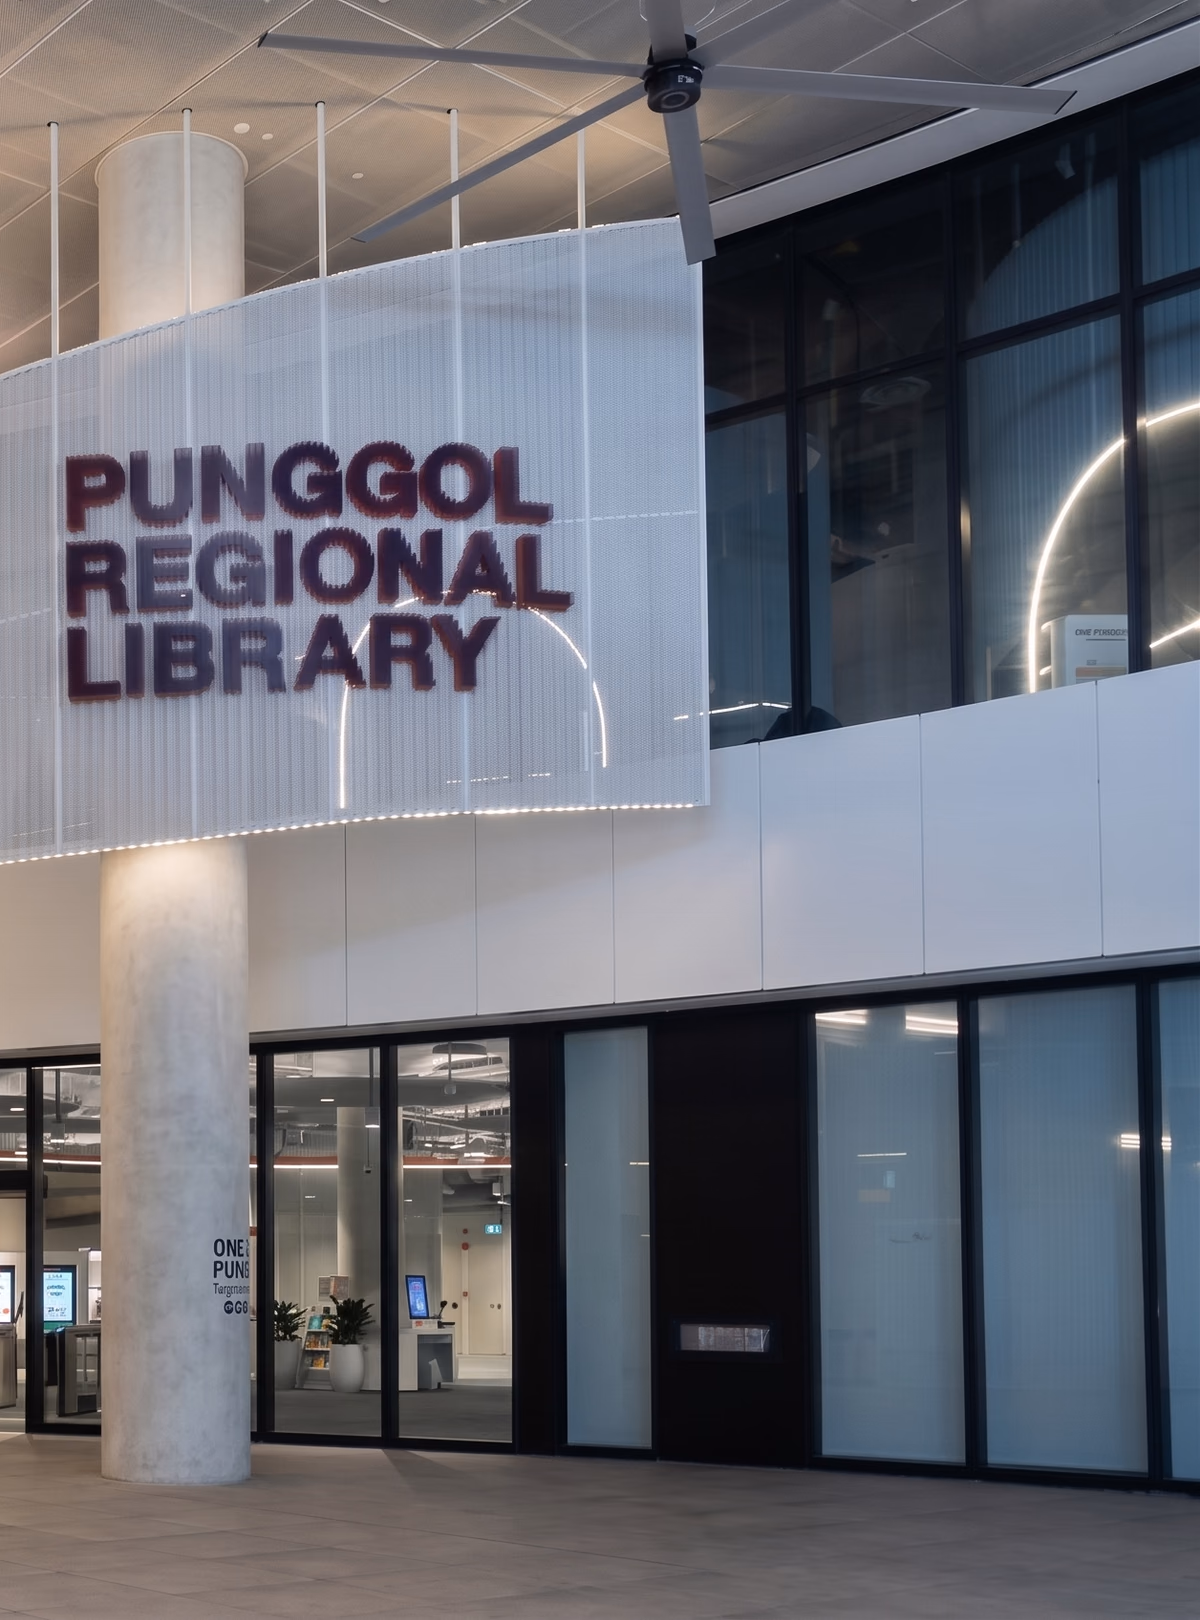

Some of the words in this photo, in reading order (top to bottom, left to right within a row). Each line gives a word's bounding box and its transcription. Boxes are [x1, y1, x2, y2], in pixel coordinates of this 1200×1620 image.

[65, 440, 554, 532] PUNGGOL
[65, 526, 575, 618] REGIONAL
[66, 612, 502, 704] LIBRARY
